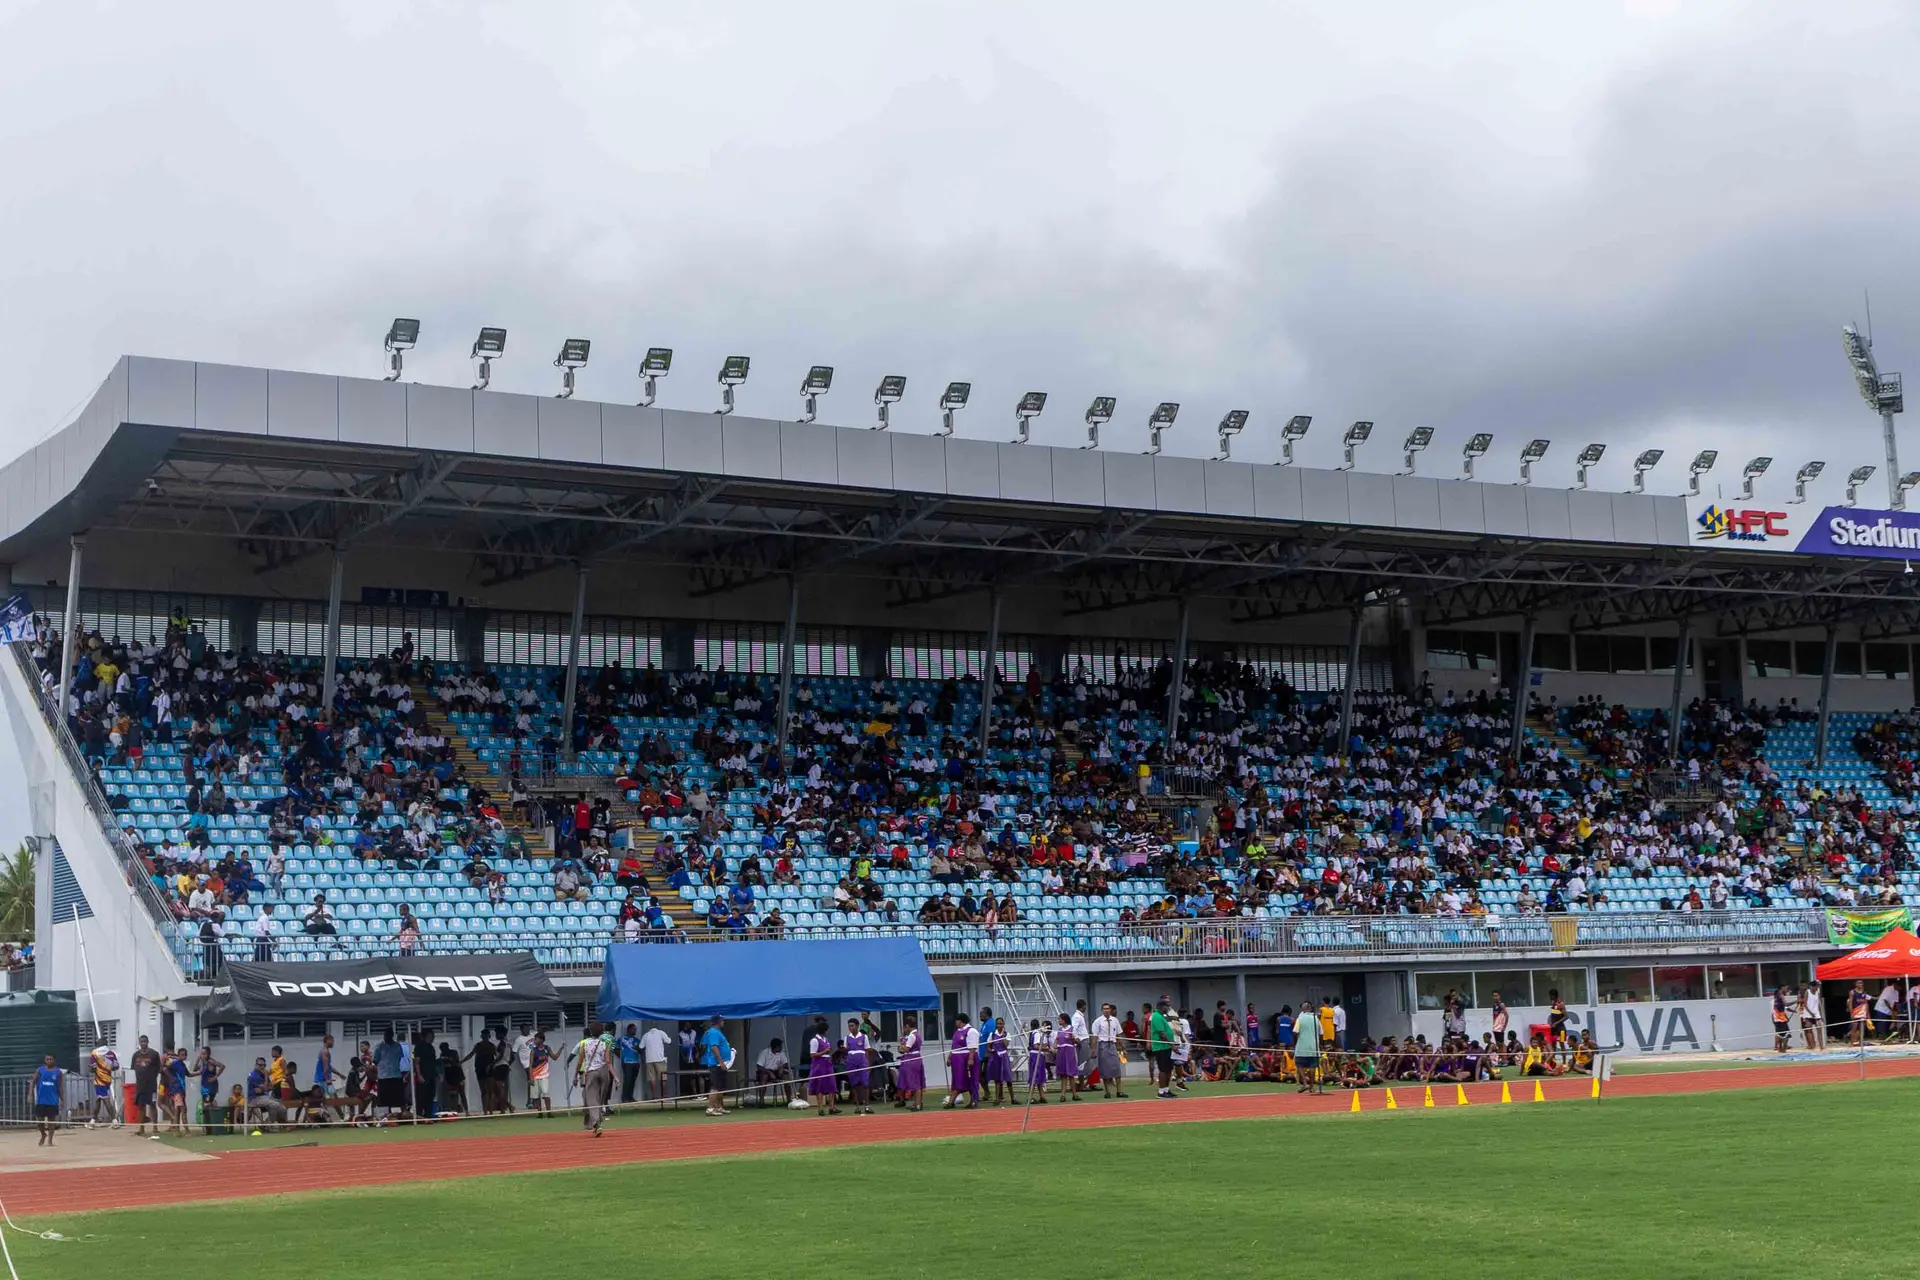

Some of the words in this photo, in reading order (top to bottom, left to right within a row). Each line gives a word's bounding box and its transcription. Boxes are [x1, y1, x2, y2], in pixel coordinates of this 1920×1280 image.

[1725, 508, 1789, 536] HFC
[1727, 531, 1768, 541] BANK
[268, 974, 512, 997] POWERADE
